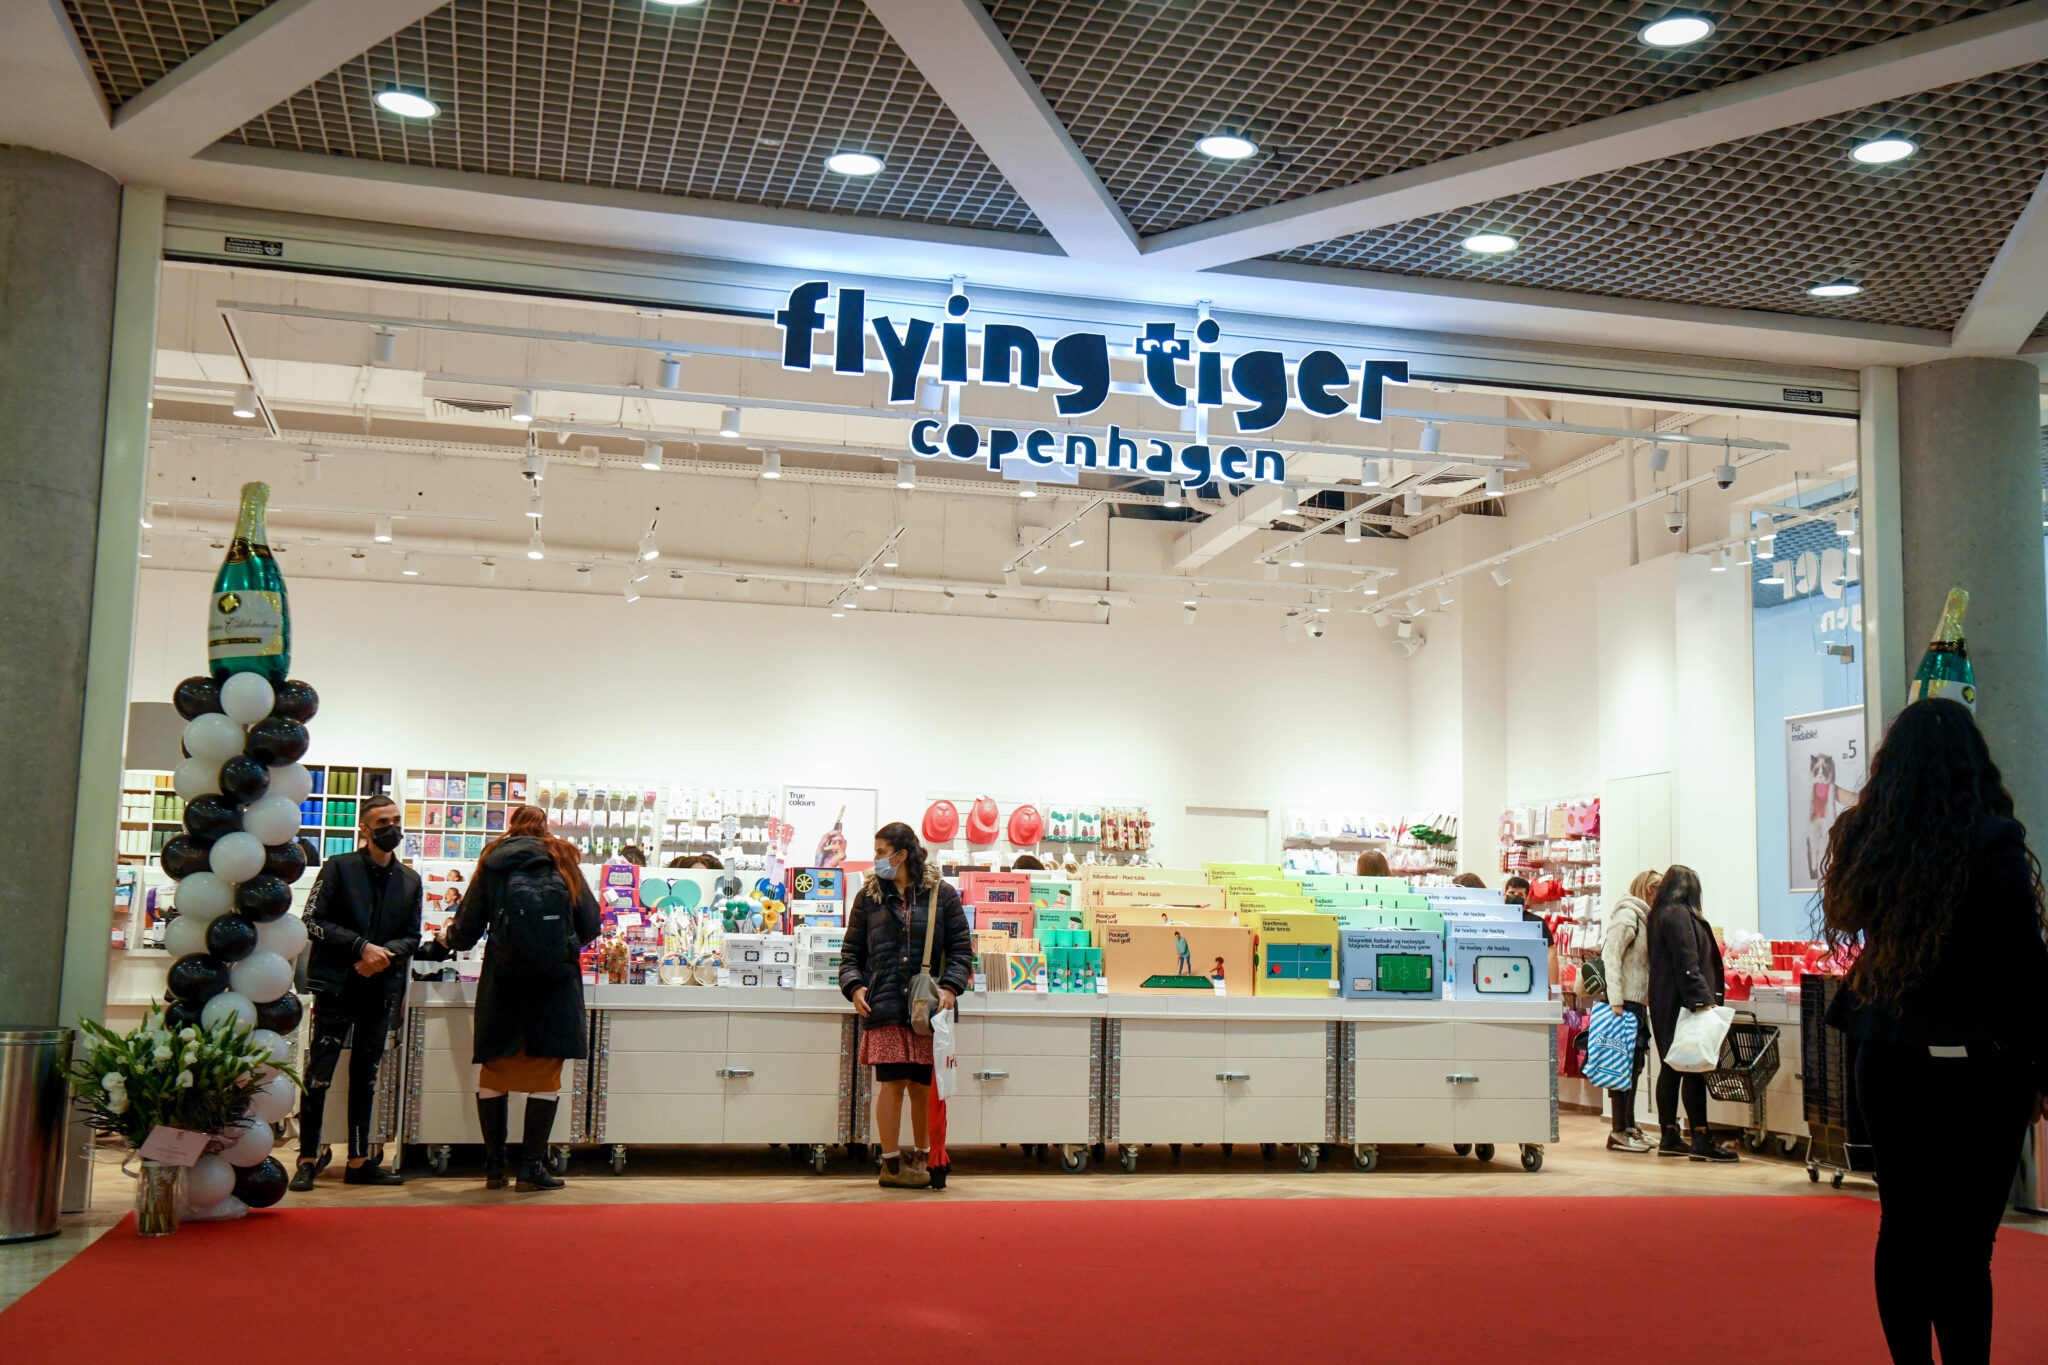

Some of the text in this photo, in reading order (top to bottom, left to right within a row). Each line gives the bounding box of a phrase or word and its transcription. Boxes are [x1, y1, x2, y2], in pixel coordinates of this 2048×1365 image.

[775, 280, 1409, 432] flying tiger
[910, 420, 1285, 488] copenhagen
[1848, 739, 1857, 759] 5
[789, 791, 806, 799] True
